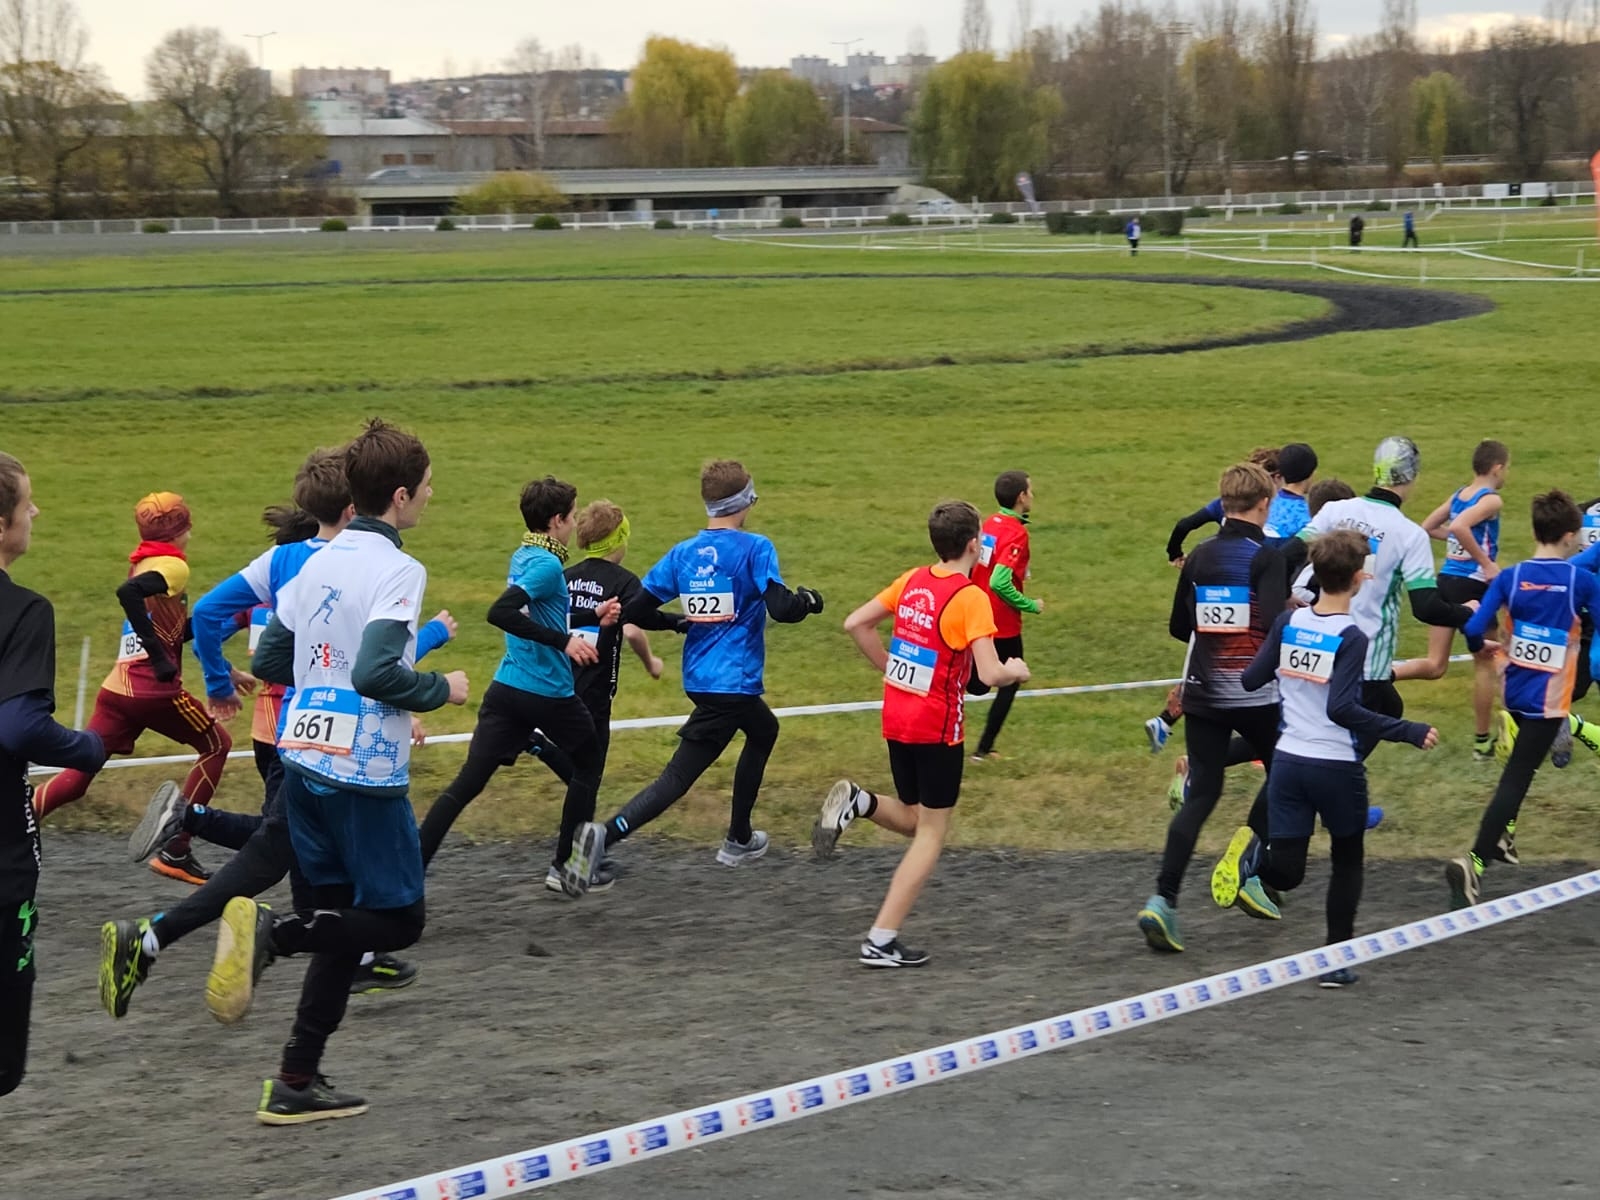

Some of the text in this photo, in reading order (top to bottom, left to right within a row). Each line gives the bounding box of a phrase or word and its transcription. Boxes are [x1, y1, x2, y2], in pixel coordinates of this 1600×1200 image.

[567, 578, 604, 597] Atletika
[687, 596, 721, 615] 622
[1203, 606, 1235, 626] 682
[1289, 649, 1321, 673] 647
[1514, 641, 1553, 664] 680
[889, 658, 917, 685] 701
[293, 713, 335, 742] 661
